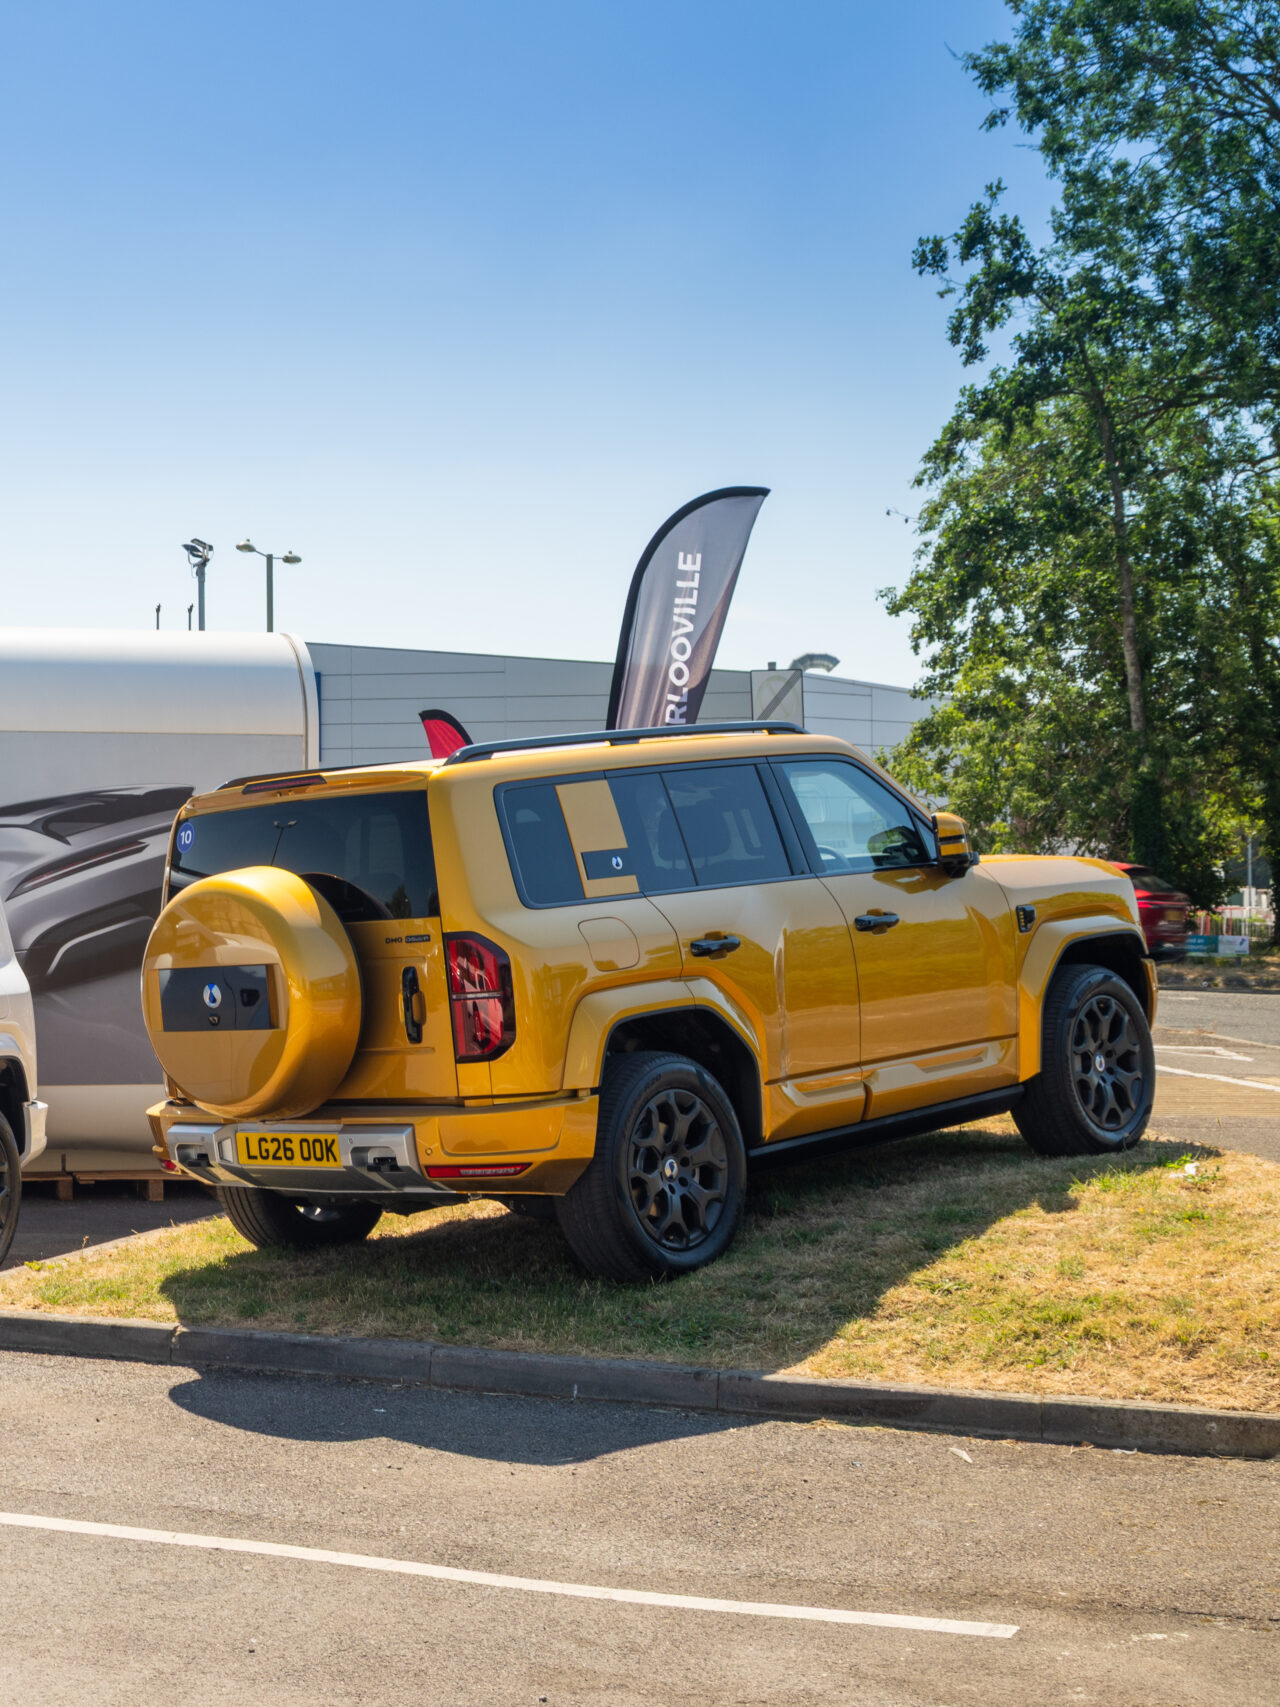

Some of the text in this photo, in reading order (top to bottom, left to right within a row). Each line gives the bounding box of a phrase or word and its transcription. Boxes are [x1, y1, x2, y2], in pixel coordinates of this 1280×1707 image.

[665, 552, 702, 725] RLOOVILLE
[180, 830, 192, 845] 10
[245, 1136, 338, 1163] LG26 OOK
